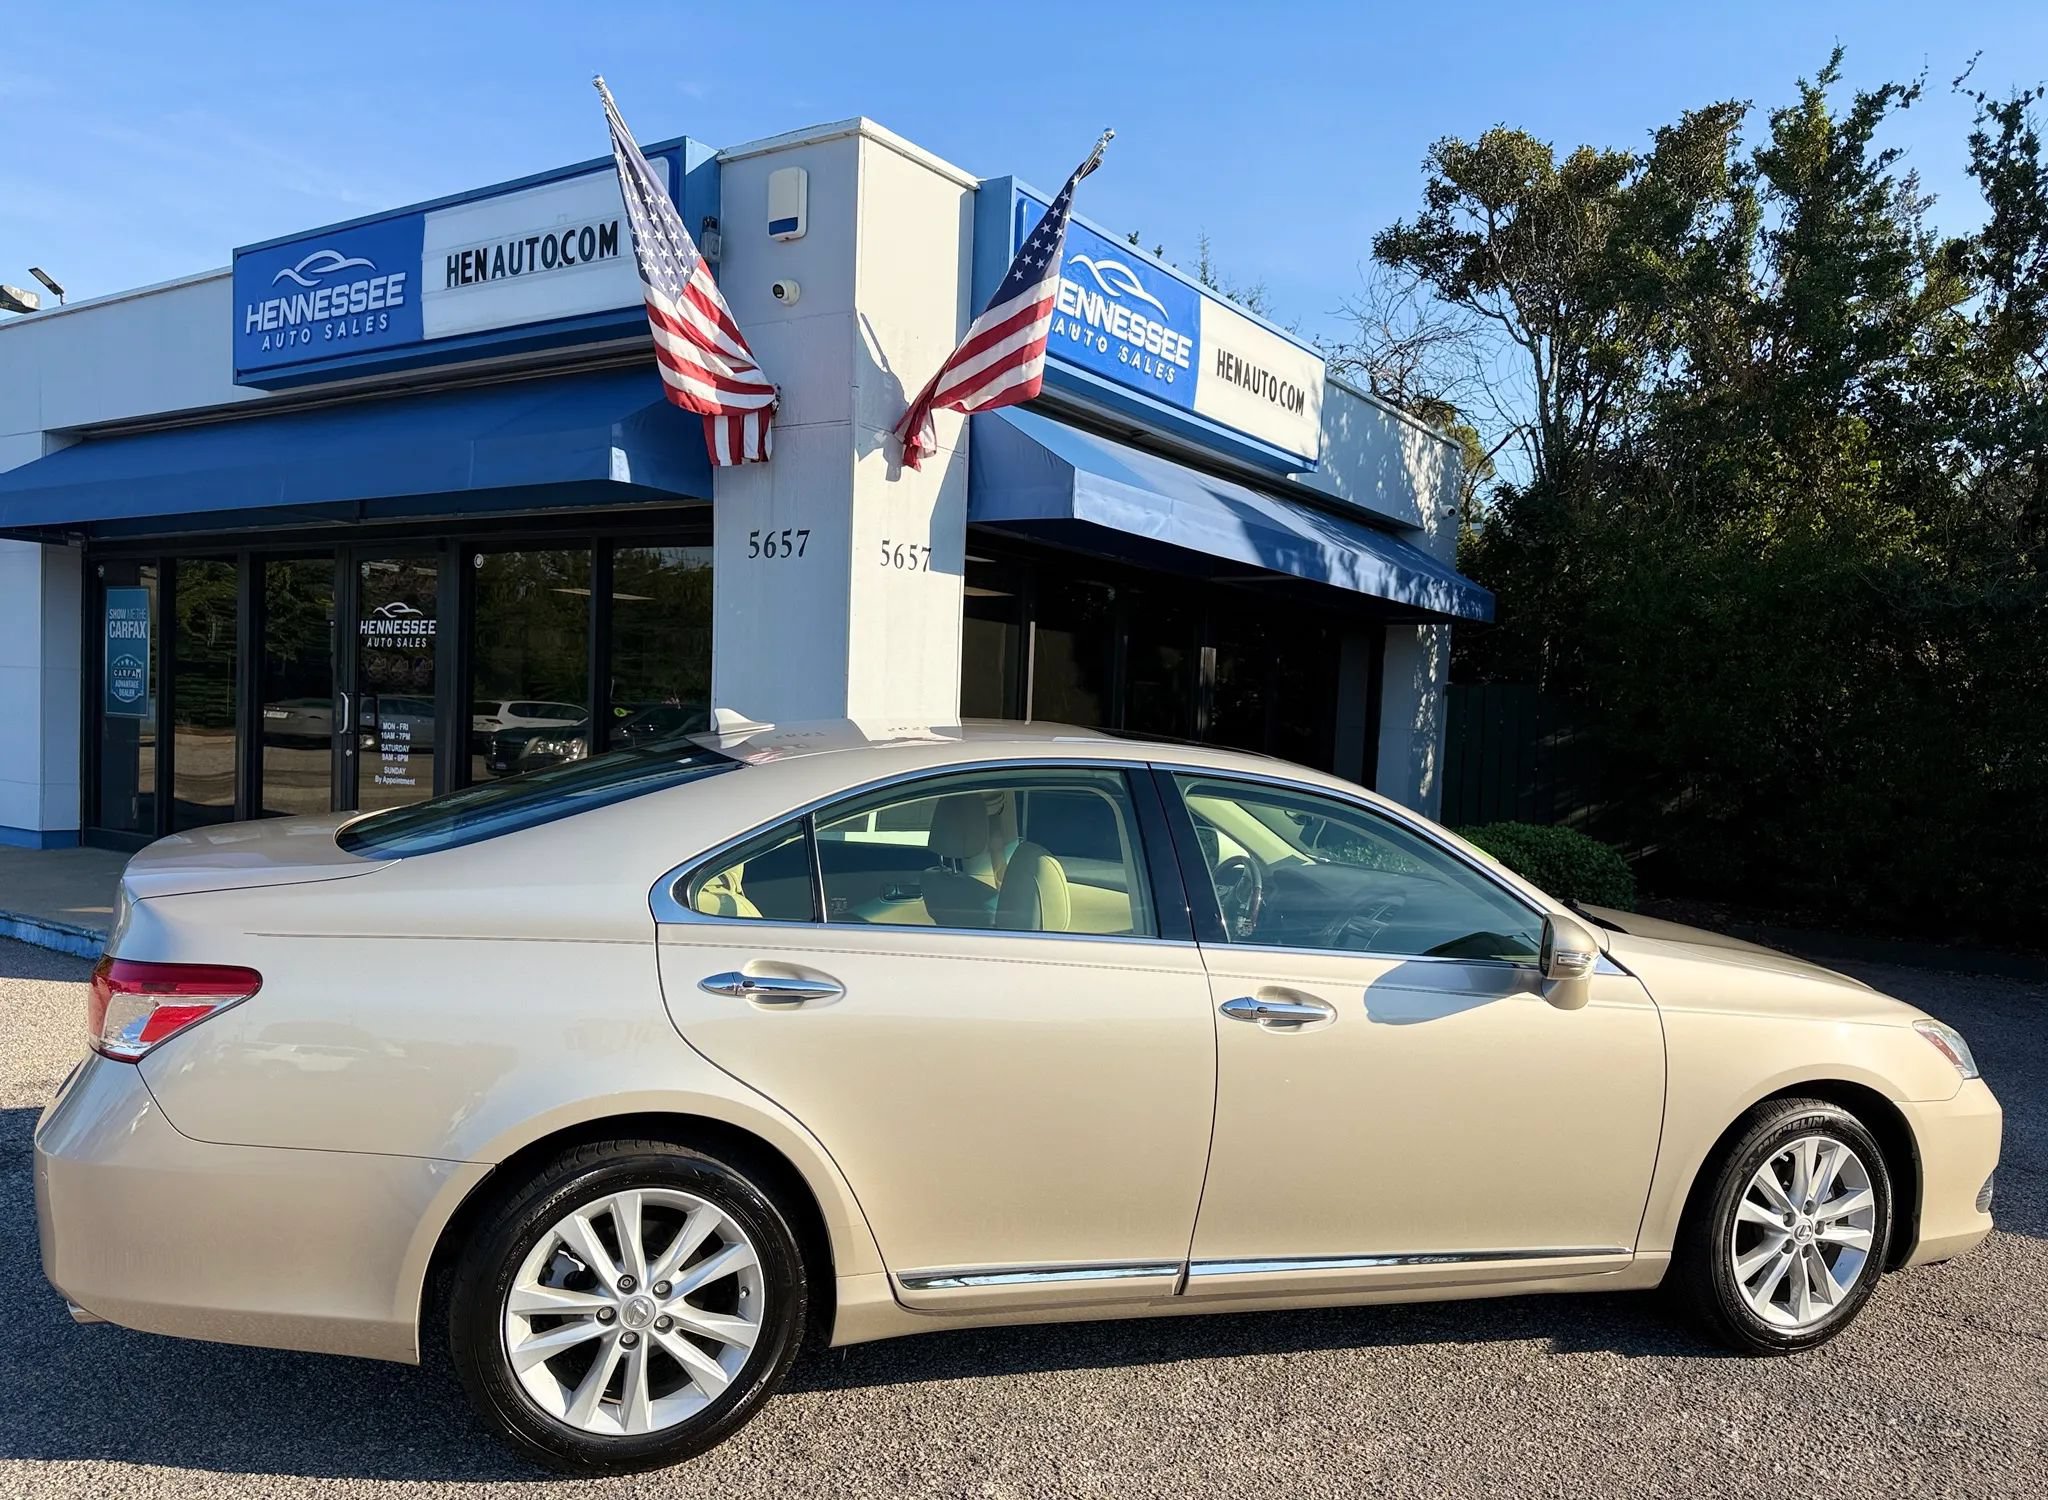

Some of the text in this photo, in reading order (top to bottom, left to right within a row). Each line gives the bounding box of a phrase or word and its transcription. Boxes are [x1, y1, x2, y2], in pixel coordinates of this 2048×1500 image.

[446, 220, 618, 289] HENAUTO.COM
[245, 272, 406, 334] HENNESSEE
[261, 313, 388, 351] AUTO SALES
[1054, 278, 1193, 370] ENNESSEE
[1053, 316, 1175, 383] AUTO SALES
[748, 528, 811, 559] 5657
[880, 539, 932, 572] 5657
[109, 608, 126, 620] SHOW
[109, 621, 146, 639] CARFAX
[359, 620, 437, 634] HENNESSEE
[366, 637, 427, 648] AUTO SALES
[118, 688, 135, 697] DEALER
[382, 722, 396, 730] MON
[399, 723, 409, 731] FRI
[399, 732, 411, 741] 7PM
[381, 744, 410, 752] SATURDAY
[384, 766, 407, 775] SUNDAY
[374, 775, 416, 786] By Appointment
[1757, 1115, 1826, 1153] MICHELIN
